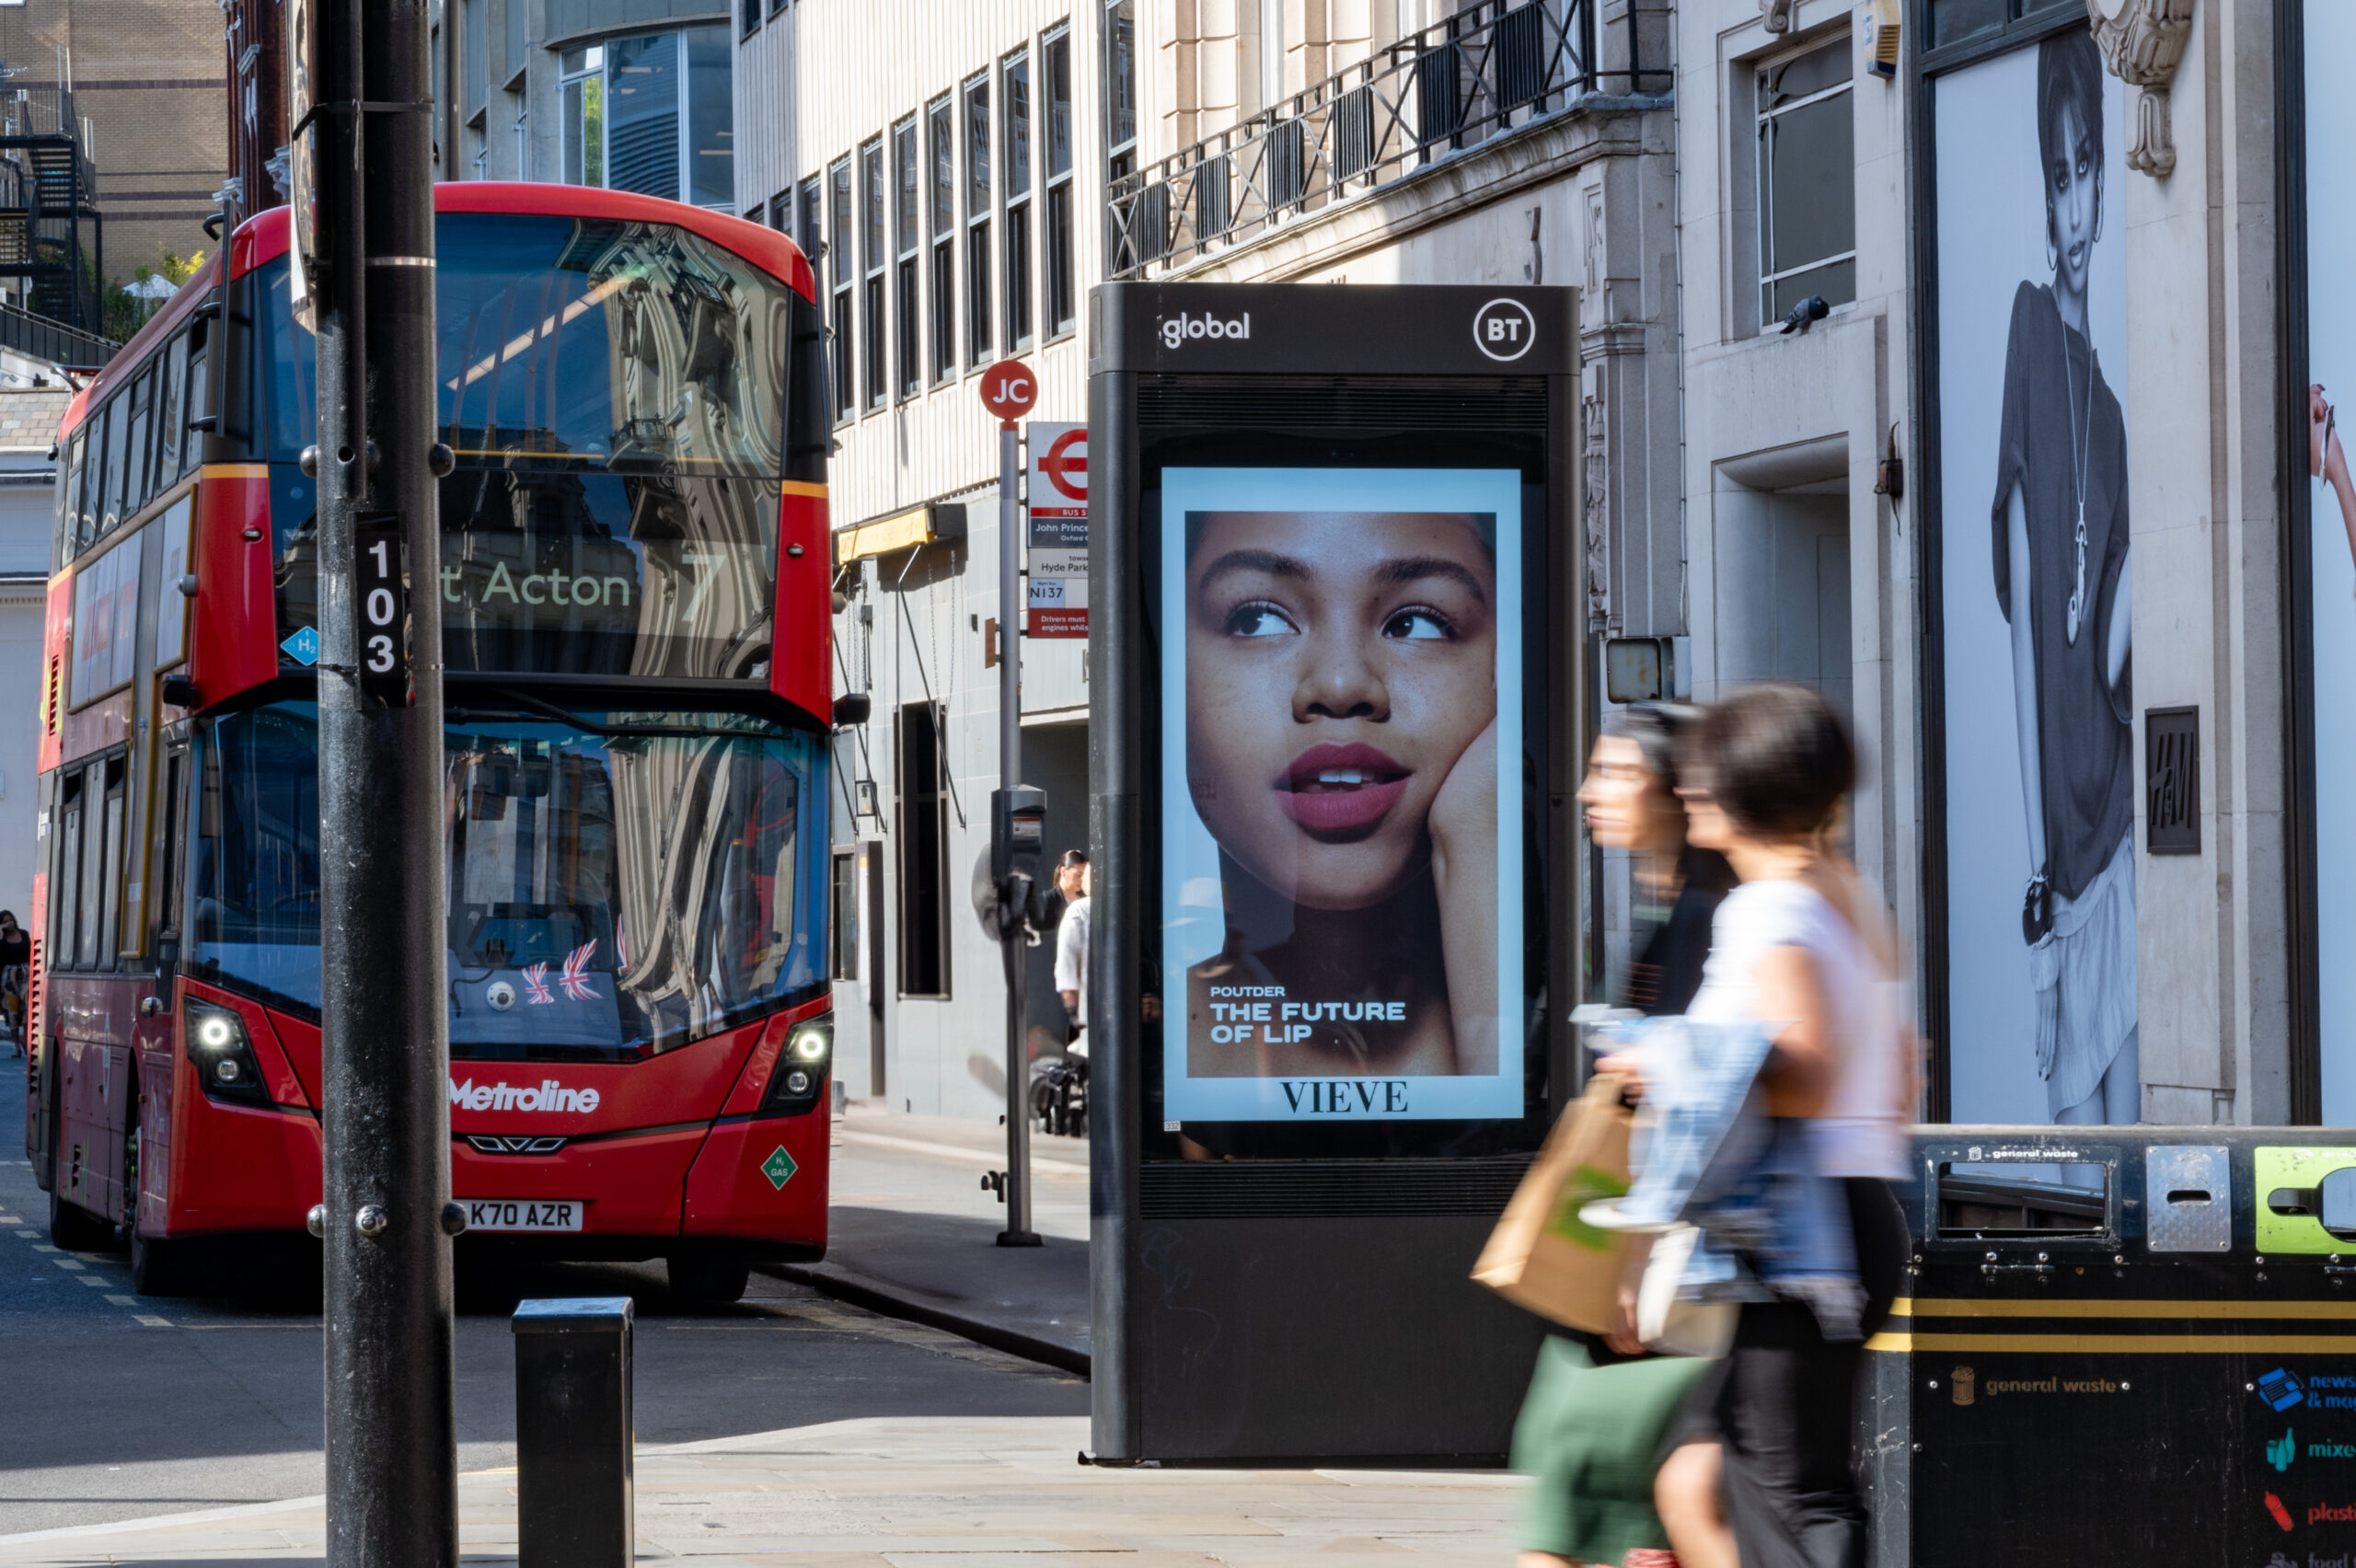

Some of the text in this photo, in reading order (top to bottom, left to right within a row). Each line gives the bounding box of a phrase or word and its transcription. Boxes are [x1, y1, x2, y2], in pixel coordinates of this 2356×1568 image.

[1162, 311, 1251, 349] global
[1487, 318, 1522, 341] BT
[992, 378, 1029, 404] JC
[1034, 524, 1058, 532] John
[1041, 562, 1065, 573] Hyde
[481, 560, 629, 605] Acton
[681, 553, 728, 623] 7
[1030, 587, 1063, 598] N137
[1041, 625, 1068, 633] engines
[1210, 986, 1287, 998] POUTDER
[1209, 1001, 1406, 1022] THE FUTURE
[1210, 1024, 1312, 1044] OF LIP
[449, 1078, 600, 1113] Metroline
[1280, 1080, 1409, 1114] VIEVE
[1992, 1149, 2079, 1159] general waste
[770, 1168, 789, 1177] GAS
[471, 1203, 572, 1227] K70 AZR
[1986, 1377, 2117, 1396] general waste
[2307, 1390, 2321, 1408] &
